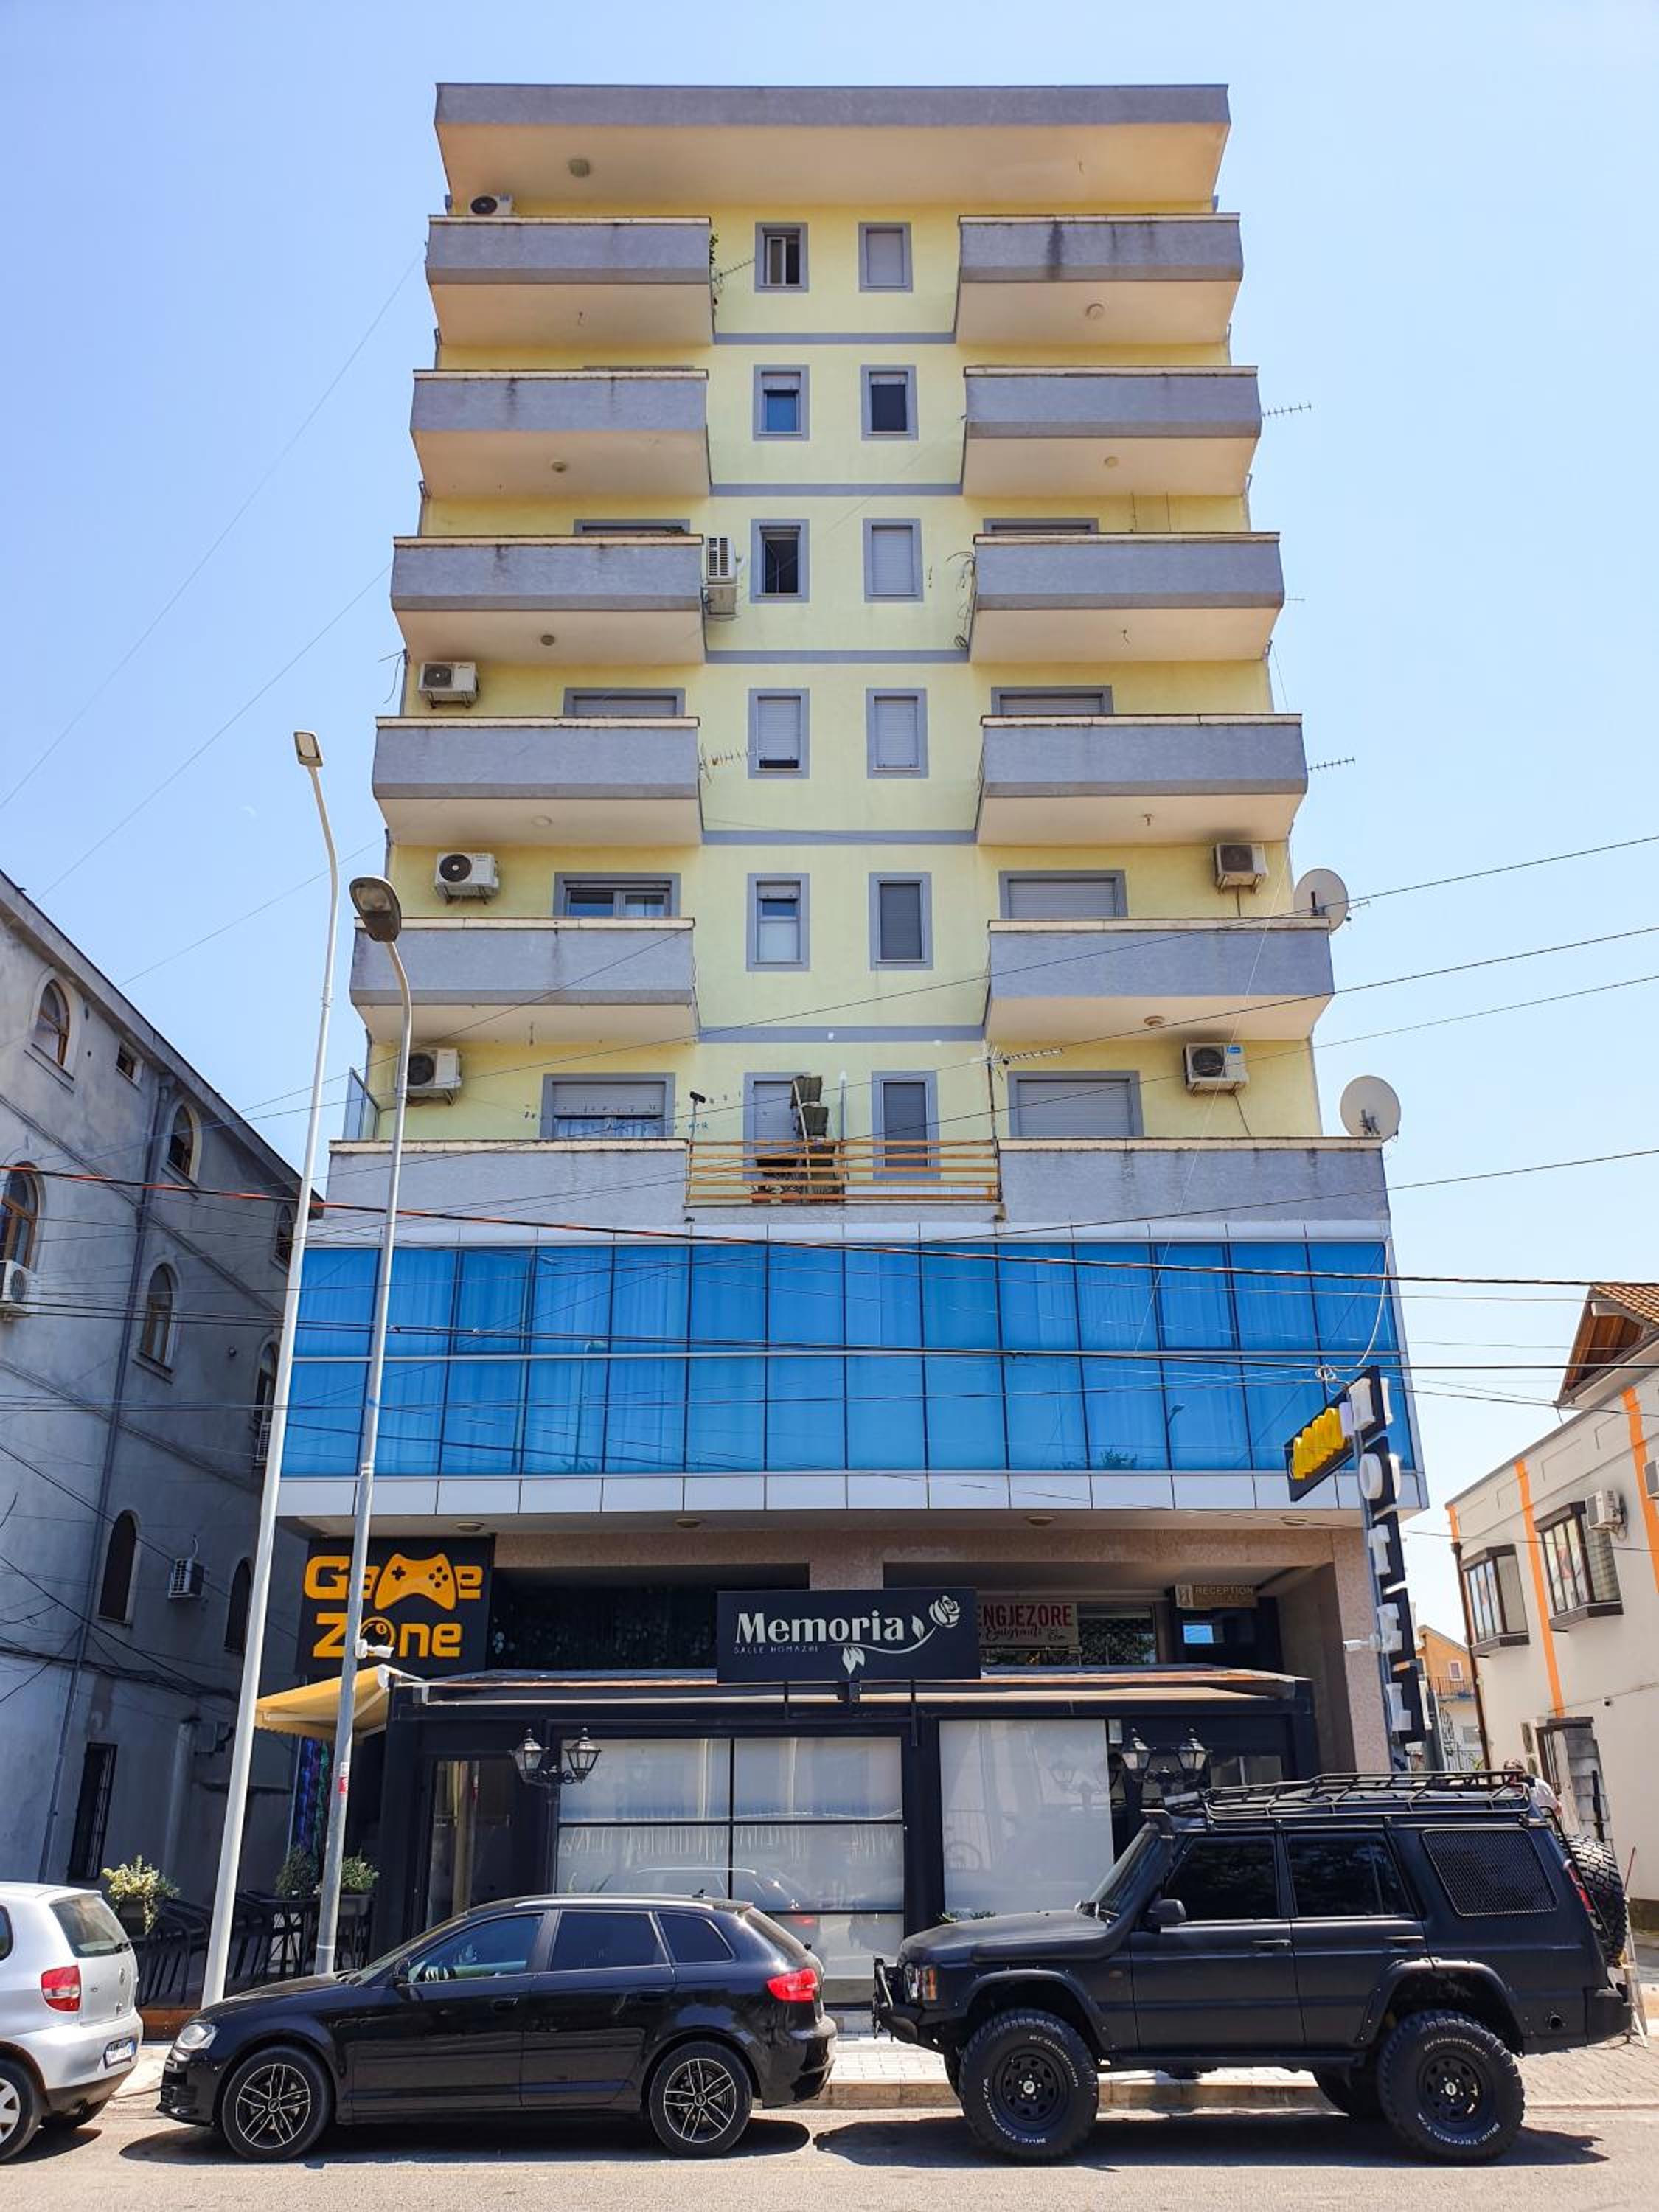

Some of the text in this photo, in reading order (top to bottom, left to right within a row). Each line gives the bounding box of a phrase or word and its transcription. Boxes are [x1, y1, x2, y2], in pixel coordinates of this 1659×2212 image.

[1194, 1586, 1253, 1595] RECEPTION
[313, 1613, 462, 1658] Zone
[736, 1610, 905, 1644] Memoria
